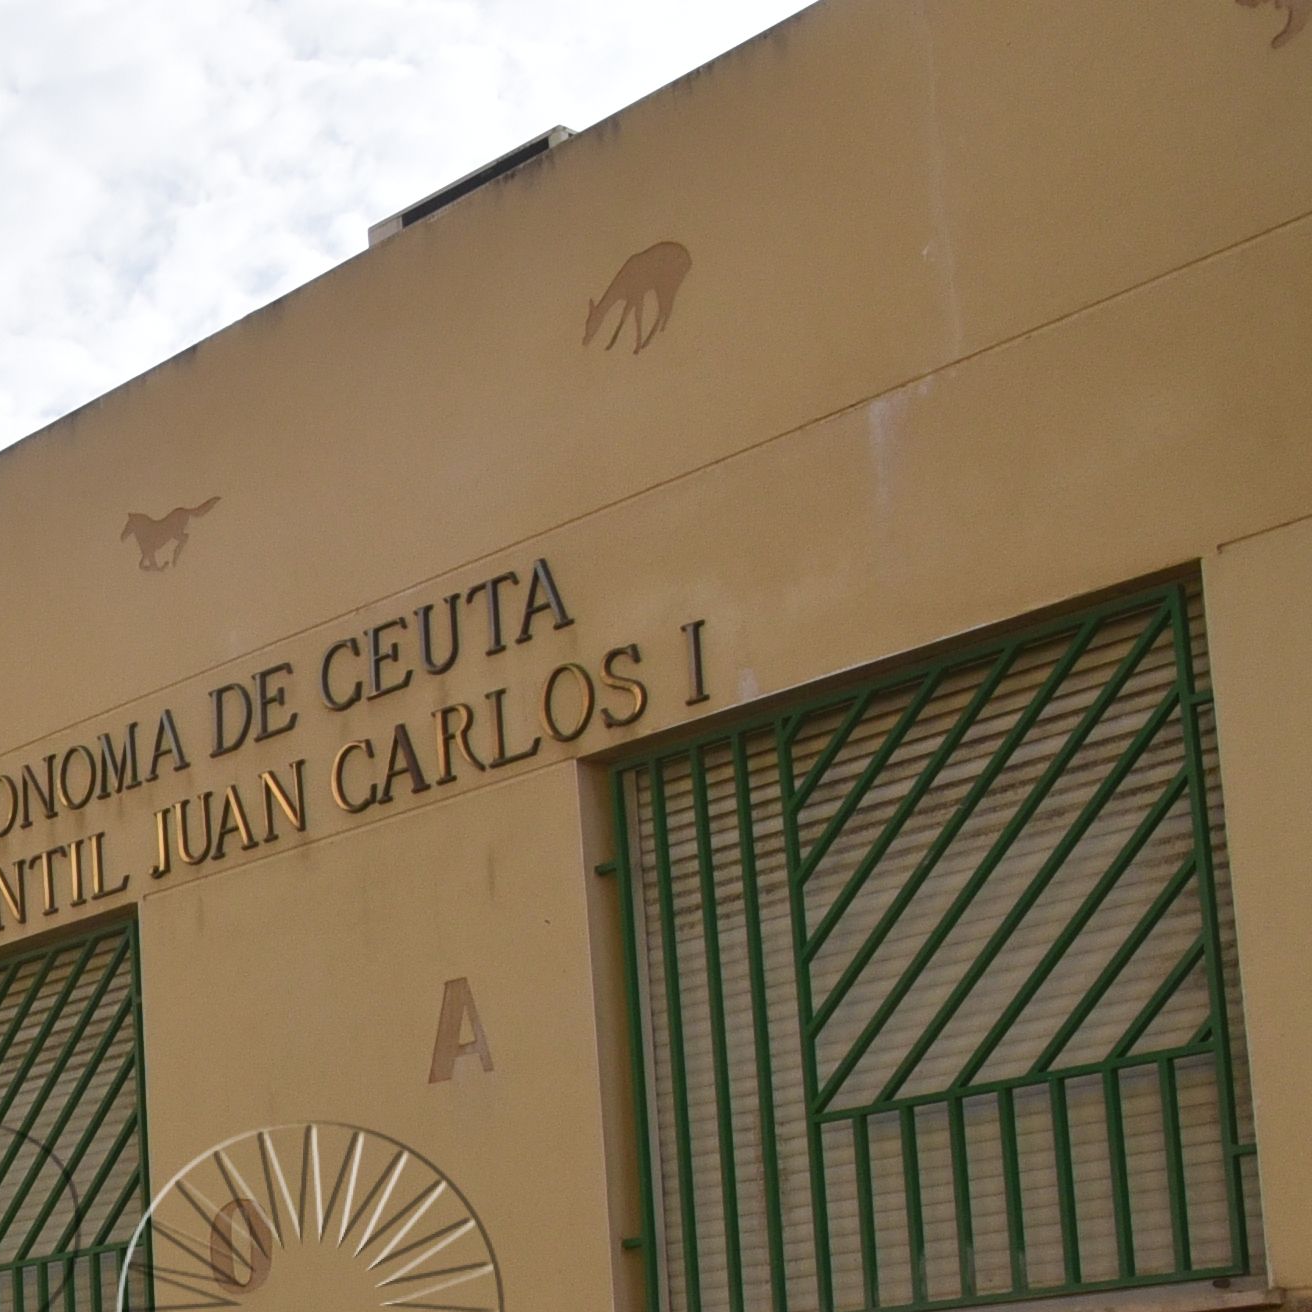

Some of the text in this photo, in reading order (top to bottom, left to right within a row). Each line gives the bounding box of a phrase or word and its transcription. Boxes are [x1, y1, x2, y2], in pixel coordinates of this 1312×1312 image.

[148, 758, 306, 879] JUAN
[330, 643, 648, 815] CARLOS
[680, 618, 711, 707] I
[208, 661, 299, 760] DE
[319, 556, 576, 713] CEUTA
